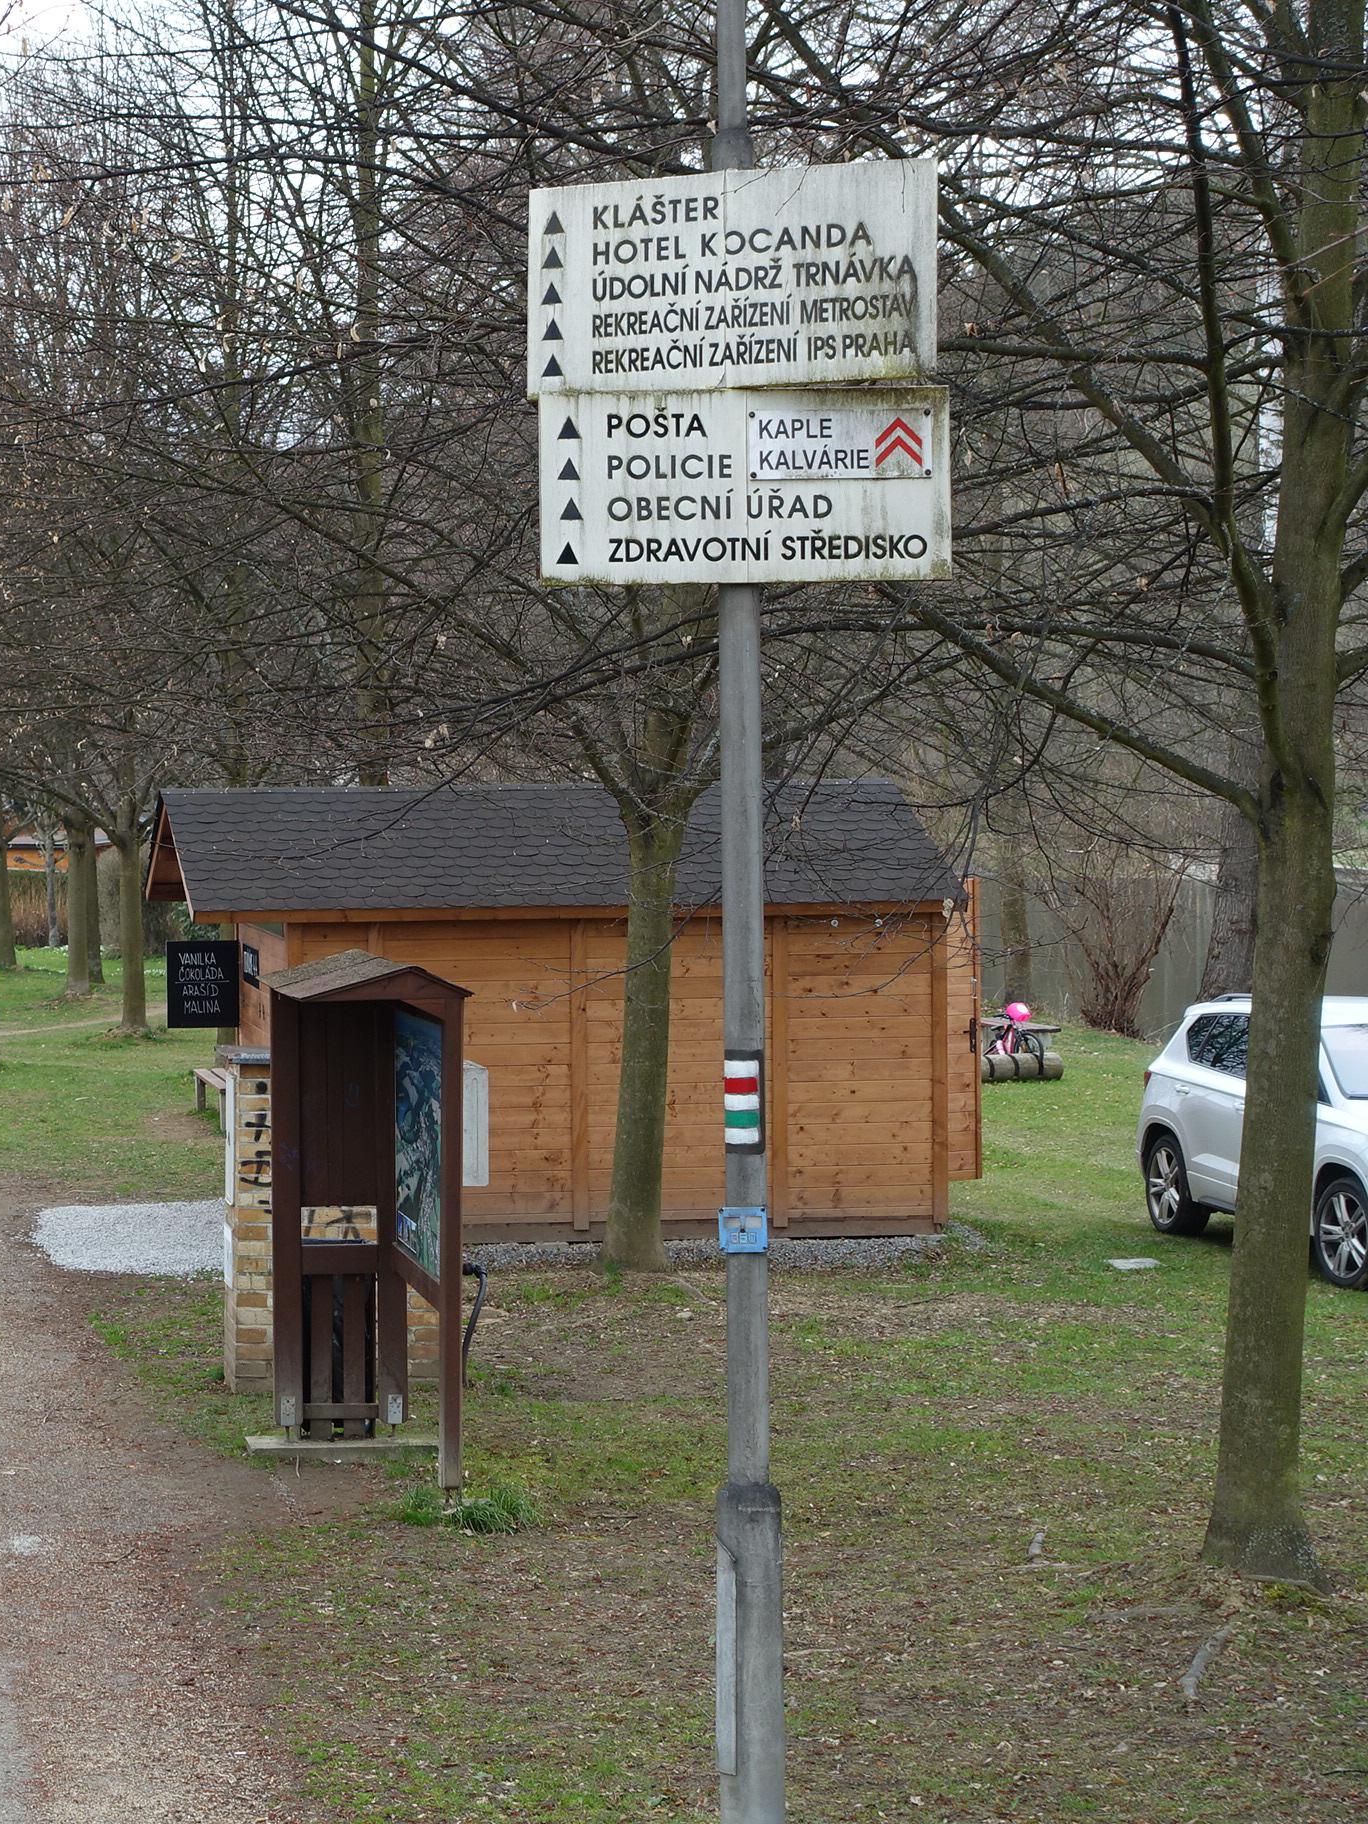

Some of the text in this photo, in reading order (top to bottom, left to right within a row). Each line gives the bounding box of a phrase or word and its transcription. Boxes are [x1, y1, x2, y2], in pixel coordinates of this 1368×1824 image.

[592, 194, 720, 230] KLÁŠTER
[592, 222, 873, 266] HOTEL KOCANDA
[592, 252, 916, 302] ÚDOLNÍ NÁDRŽ TRNÁVKA
[592, 292, 917, 338] REKREAČNÍ ZAŘÍZENÍ METROSTAV
[592, 328, 915, 375] REKREAČNÍ ZAŘÍZENÍ IPS PRAHA
[606, 406, 708, 439] POŠTA
[758, 418, 833, 440] KAPLE
[607, 454, 732, 480] POLICIE
[759, 444, 870, 470] KALVÁRIE
[607, 487, 833, 522] OBECNÍ ÚŘAD
[608, 529, 928, 563] ZDRAVOTNÍ STŘEDISKO
[178, 952, 217, 966] VANILKA
[178, 965, 225, 982] ČOKOLÁDA
[182, 982, 219, 997] ARAŠÍD
[183, 1000, 221, 1014] MALINA
